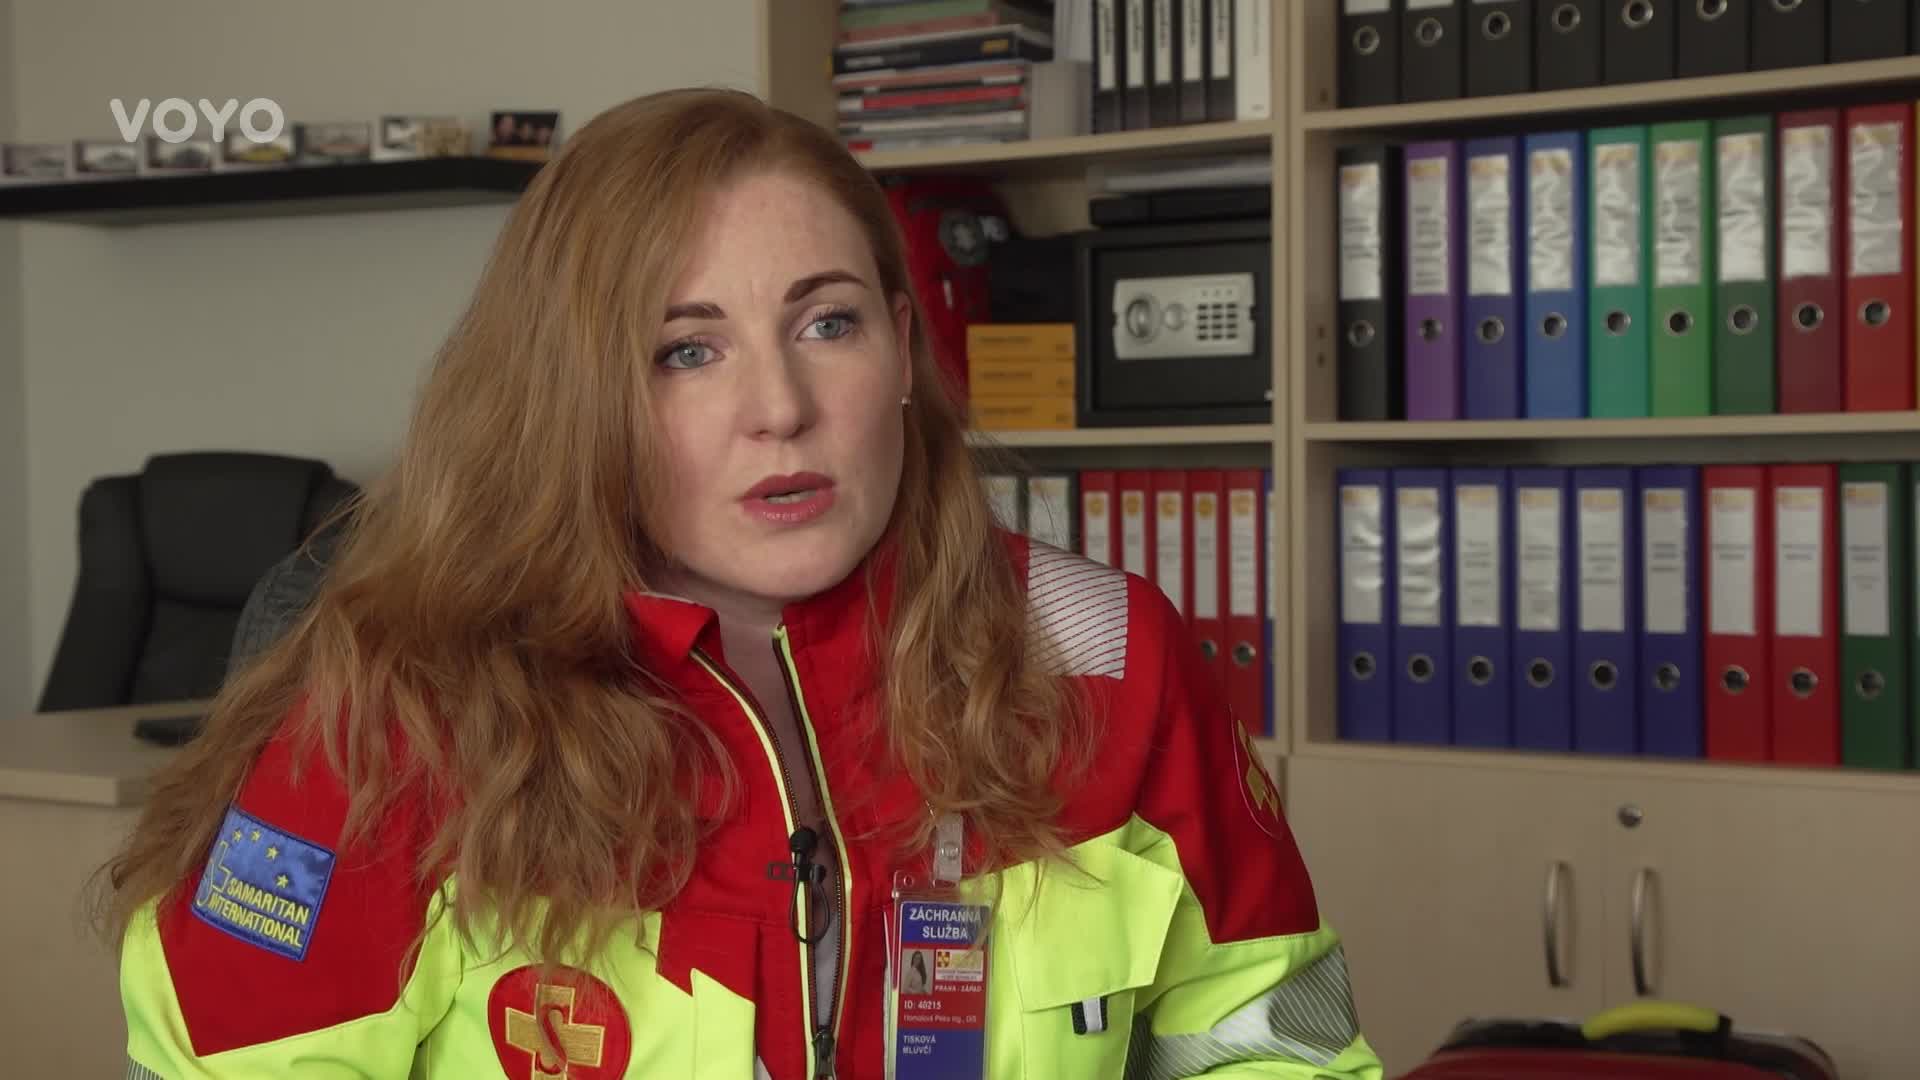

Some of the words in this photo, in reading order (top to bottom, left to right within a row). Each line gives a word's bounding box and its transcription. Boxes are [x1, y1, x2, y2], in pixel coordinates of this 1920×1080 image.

[208, 892, 303, 948] INTERNATIONAL
[227, 877, 309, 926] SAMARITAN
[922, 924, 968, 939] SLUŽBA
